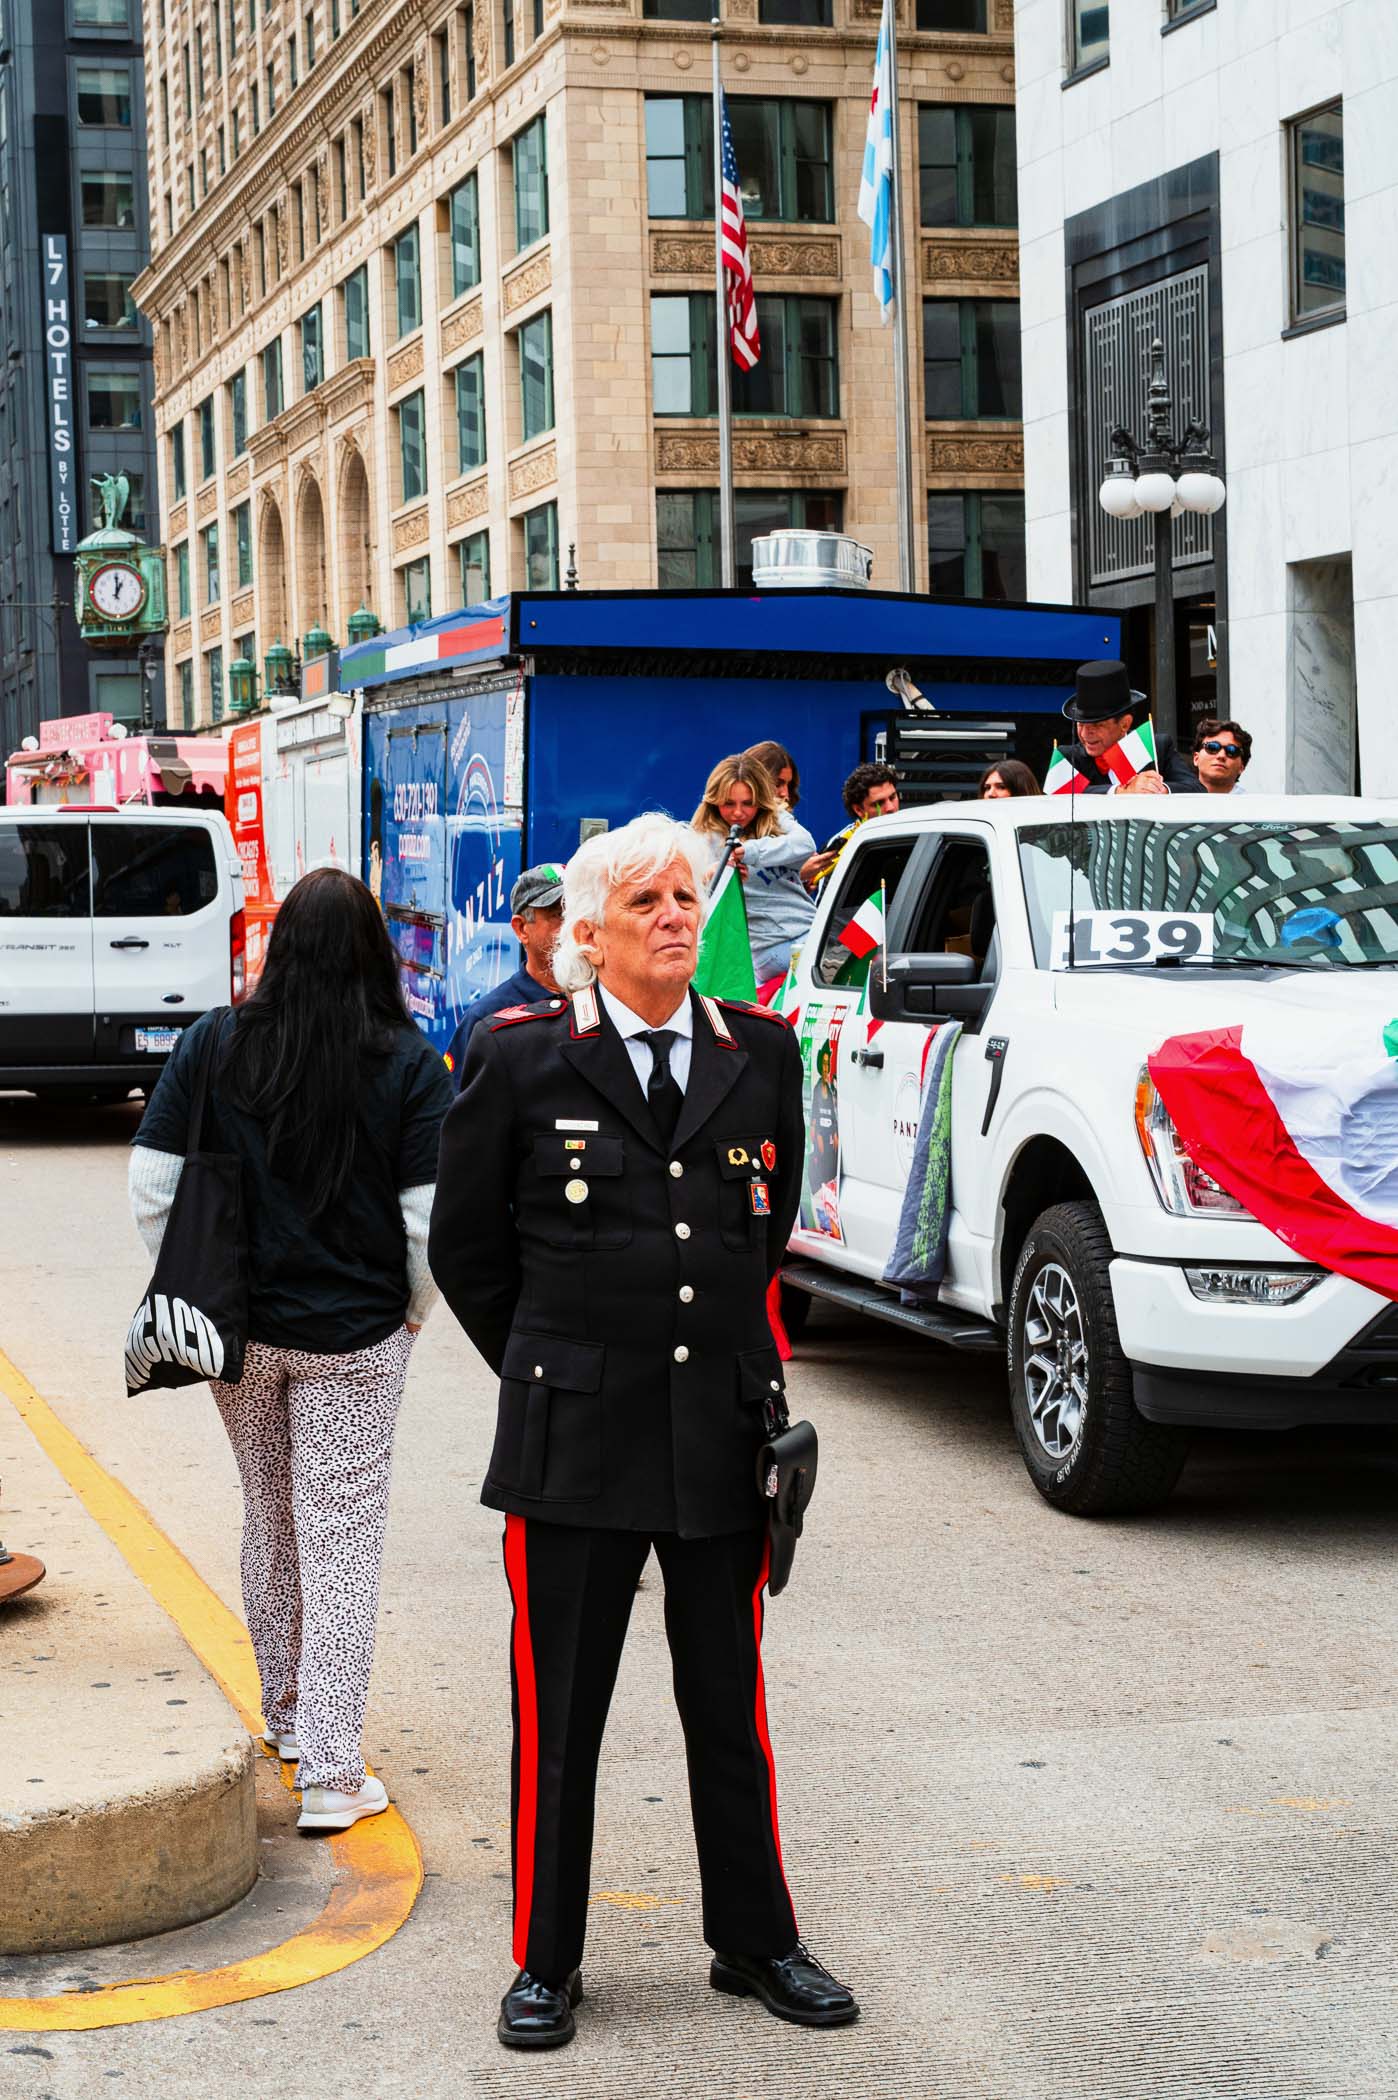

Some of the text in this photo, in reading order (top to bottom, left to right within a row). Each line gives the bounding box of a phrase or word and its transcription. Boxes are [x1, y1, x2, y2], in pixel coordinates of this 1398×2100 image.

[46, 237, 71, 551] L7 HOTELS BY LOTTE
[394, 782, 438, 822] 630-720-1391
[1062, 918, 1201, 962] 139
